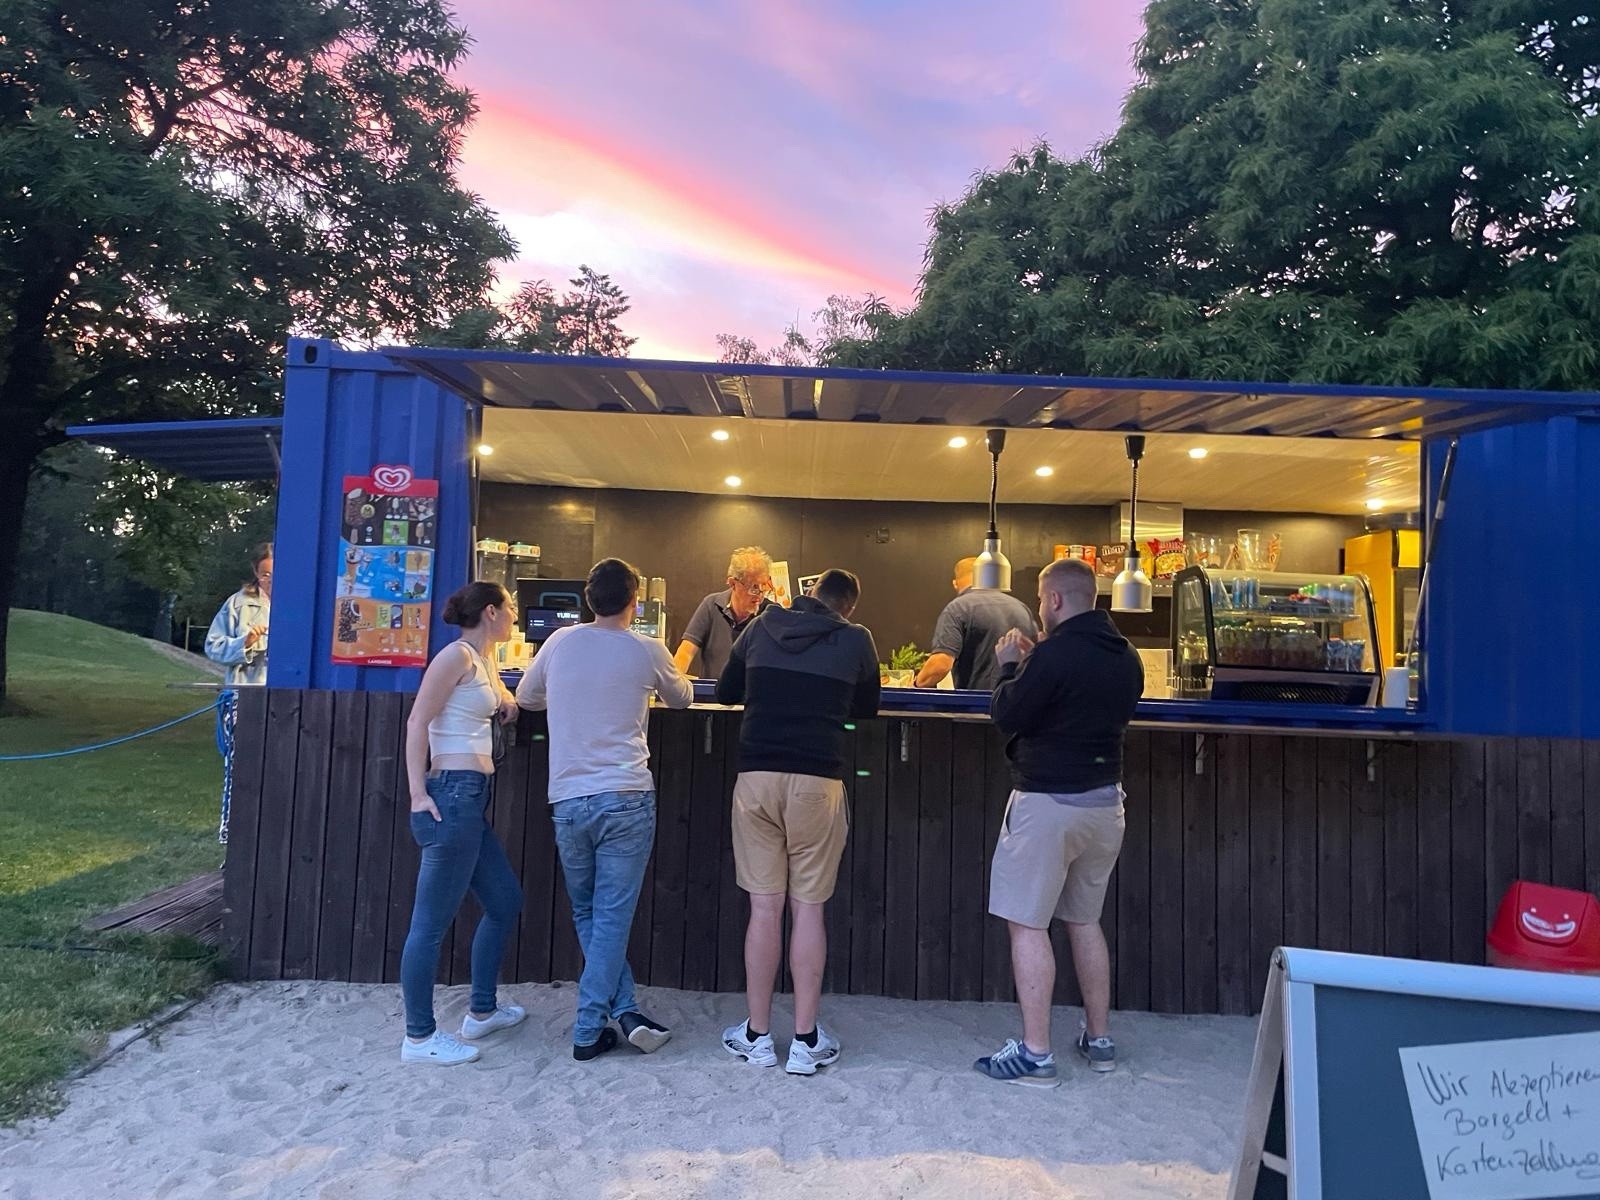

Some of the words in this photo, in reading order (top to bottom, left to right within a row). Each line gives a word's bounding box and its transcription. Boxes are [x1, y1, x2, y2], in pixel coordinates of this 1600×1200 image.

[1416, 1061, 1470, 1106] Wir
[1443, 1099, 1552, 1141] Bargeld
[1562, 1103, 1579, 1119] +
